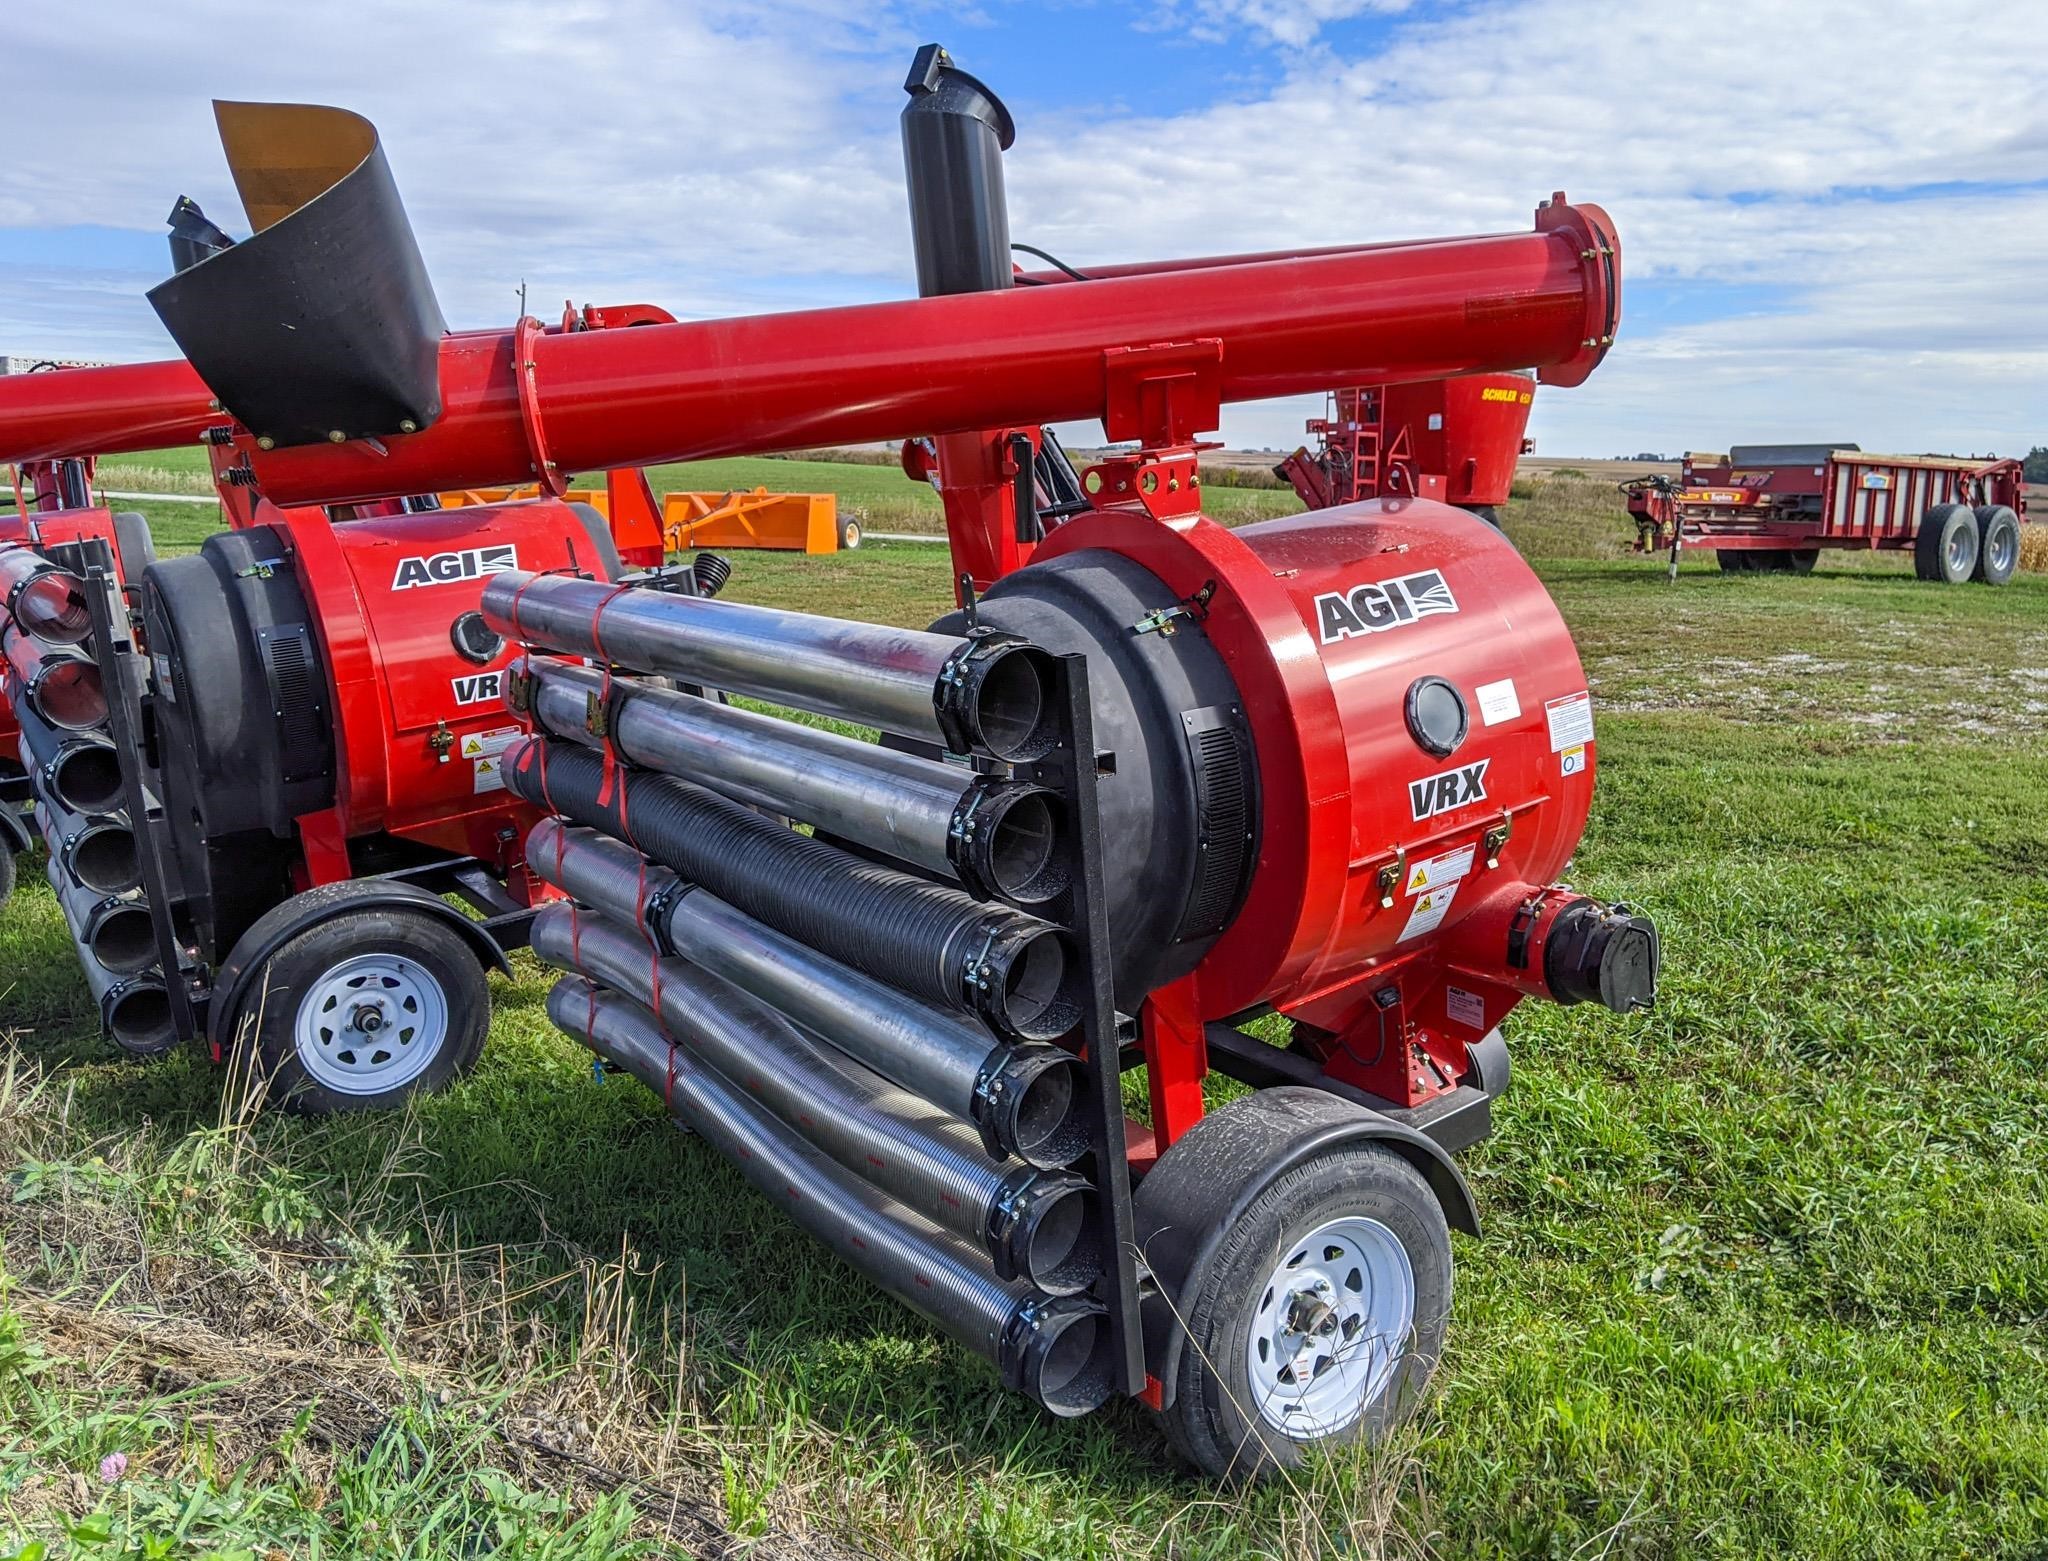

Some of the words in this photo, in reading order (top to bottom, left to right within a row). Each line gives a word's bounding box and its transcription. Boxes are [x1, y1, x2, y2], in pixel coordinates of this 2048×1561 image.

[1481, 387, 1518, 402] SCHULER
[396, 551, 477, 587] AGI
[1319, 582, 1414, 639] AGI
[454, 674, 500, 702] VR
[1411, 763, 1486, 818] VRX
